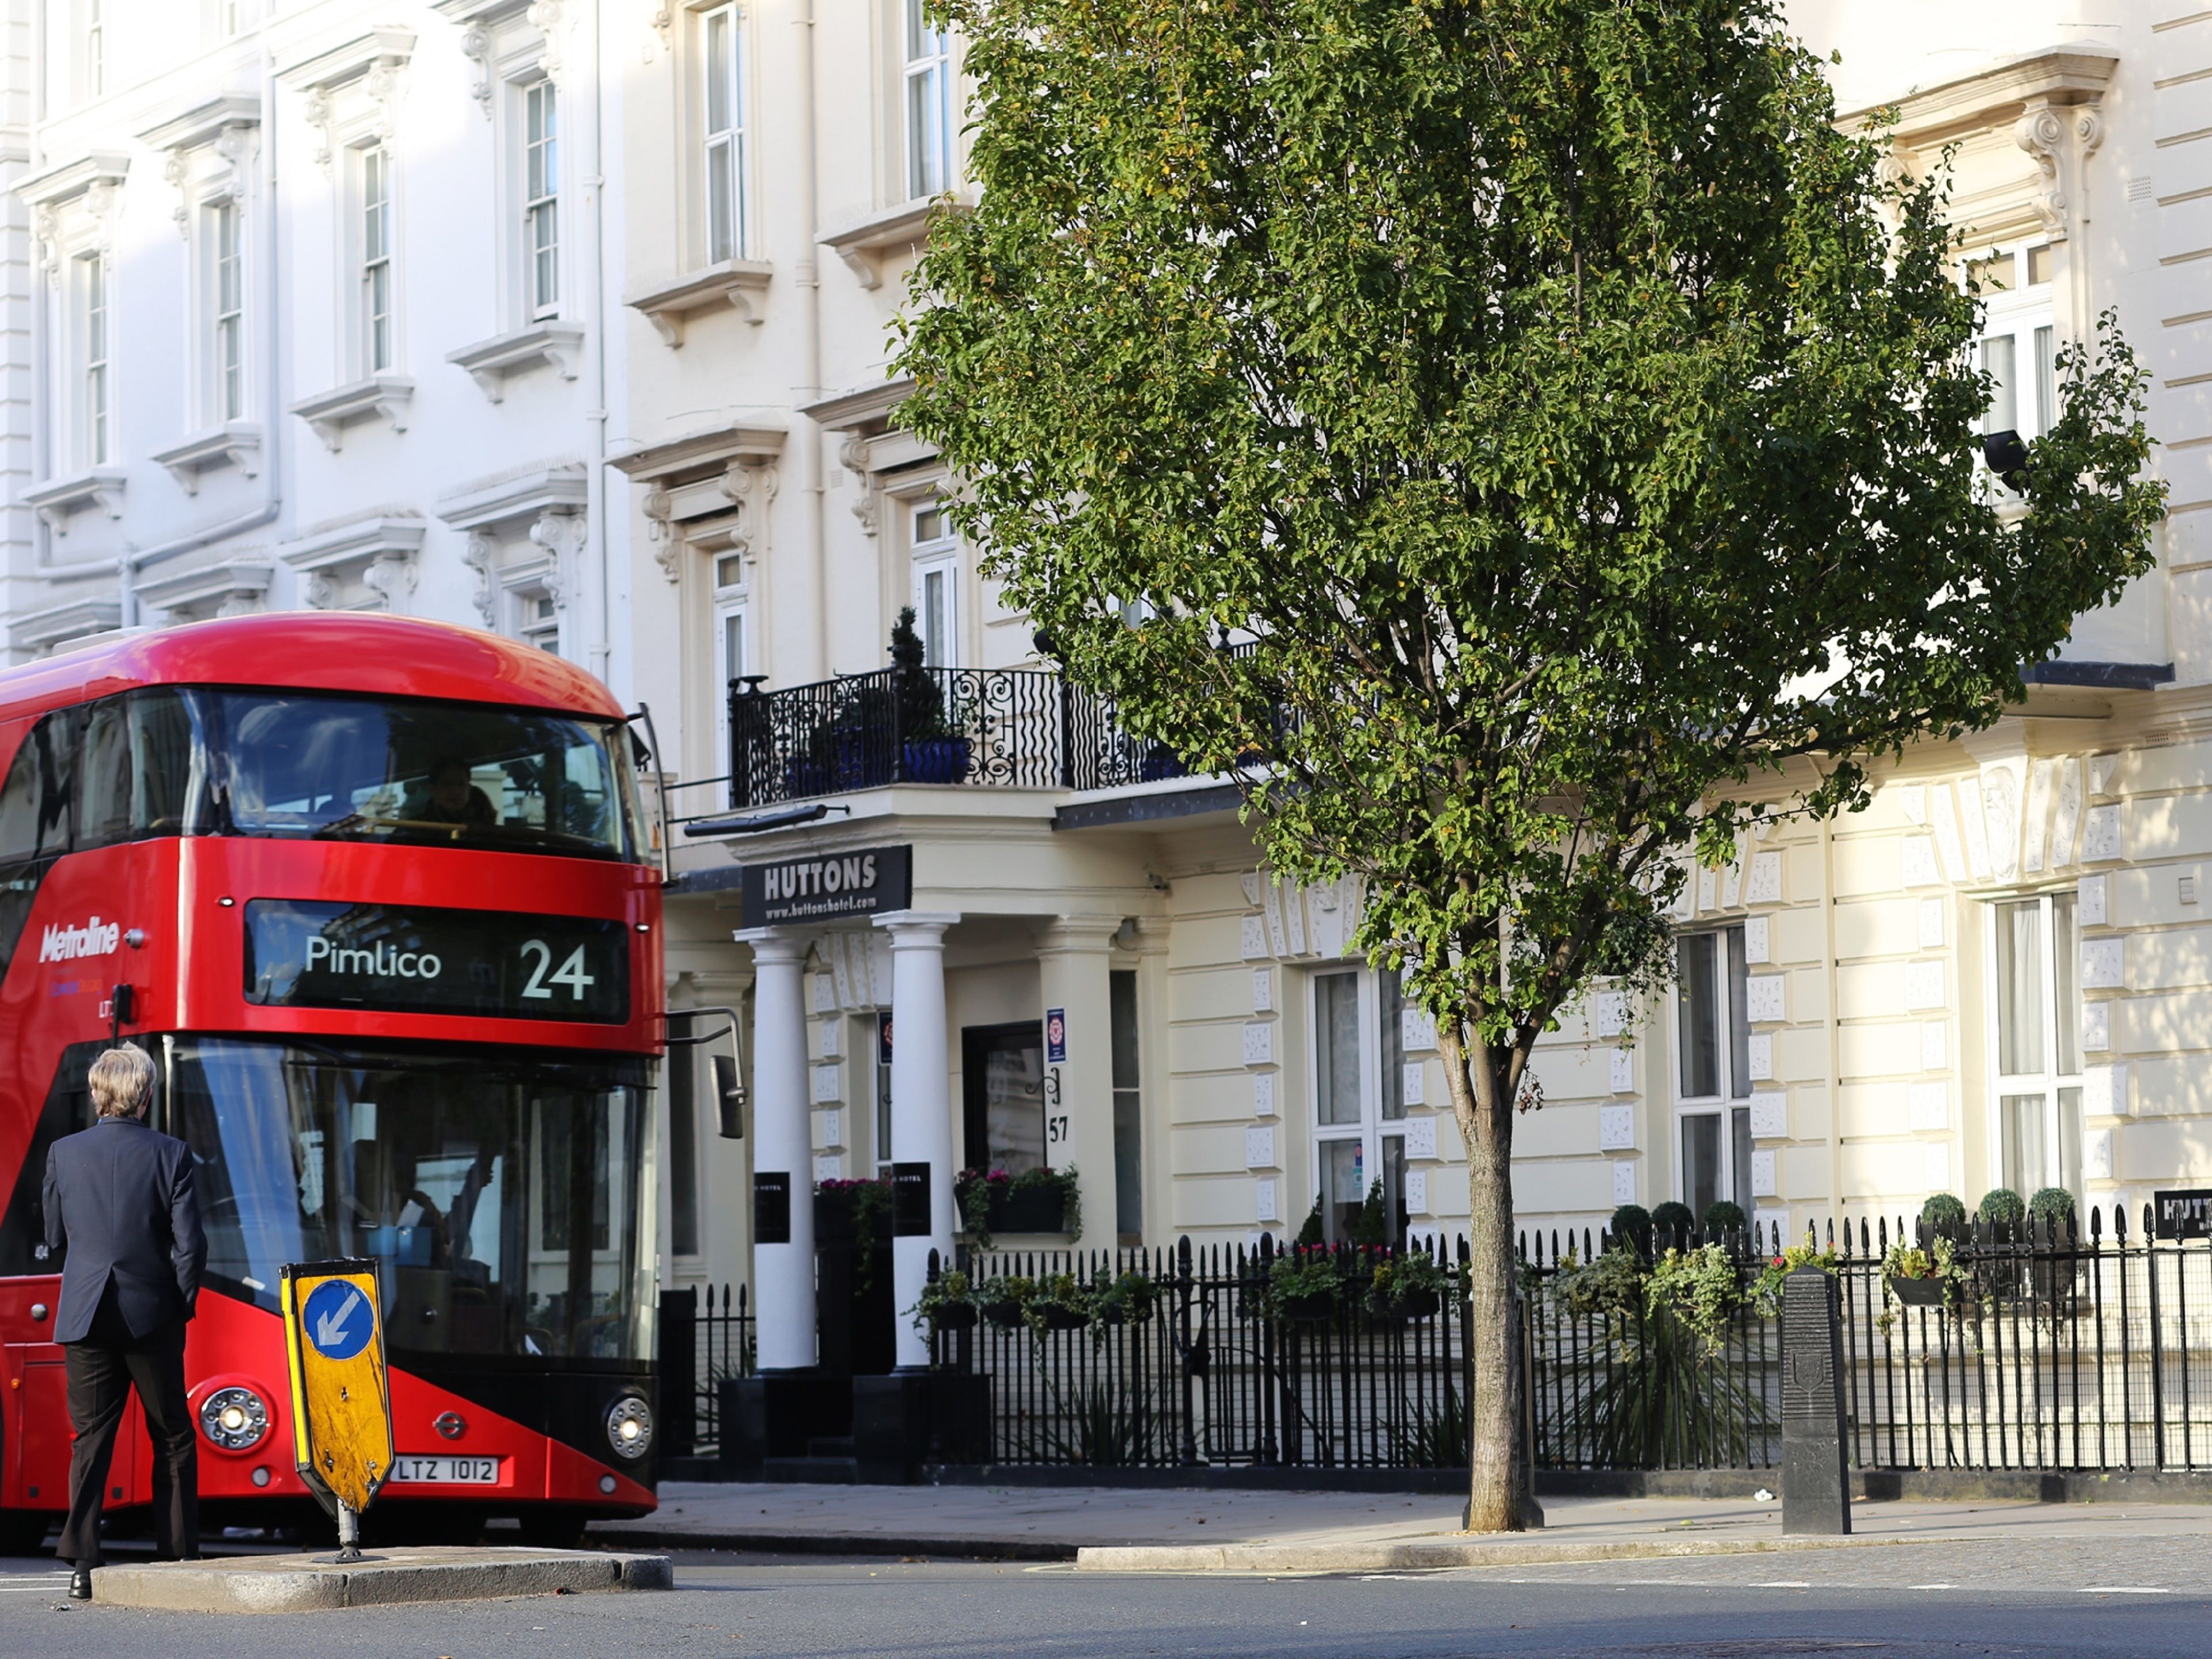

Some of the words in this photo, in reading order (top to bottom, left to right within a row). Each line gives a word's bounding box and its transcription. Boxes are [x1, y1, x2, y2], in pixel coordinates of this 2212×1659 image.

[764, 855, 877, 900] HUTTONS
[766, 896, 876, 919] www.huttonshotel.com
[39, 916, 119, 963] Metroline
[305, 935, 441, 978] Pimlico
[520, 939, 594, 1000] 24
[1049, 1116, 1068, 1142] 57
[399, 1461, 438, 1480] LTZ
[452, 1461, 492, 1480] 1012
